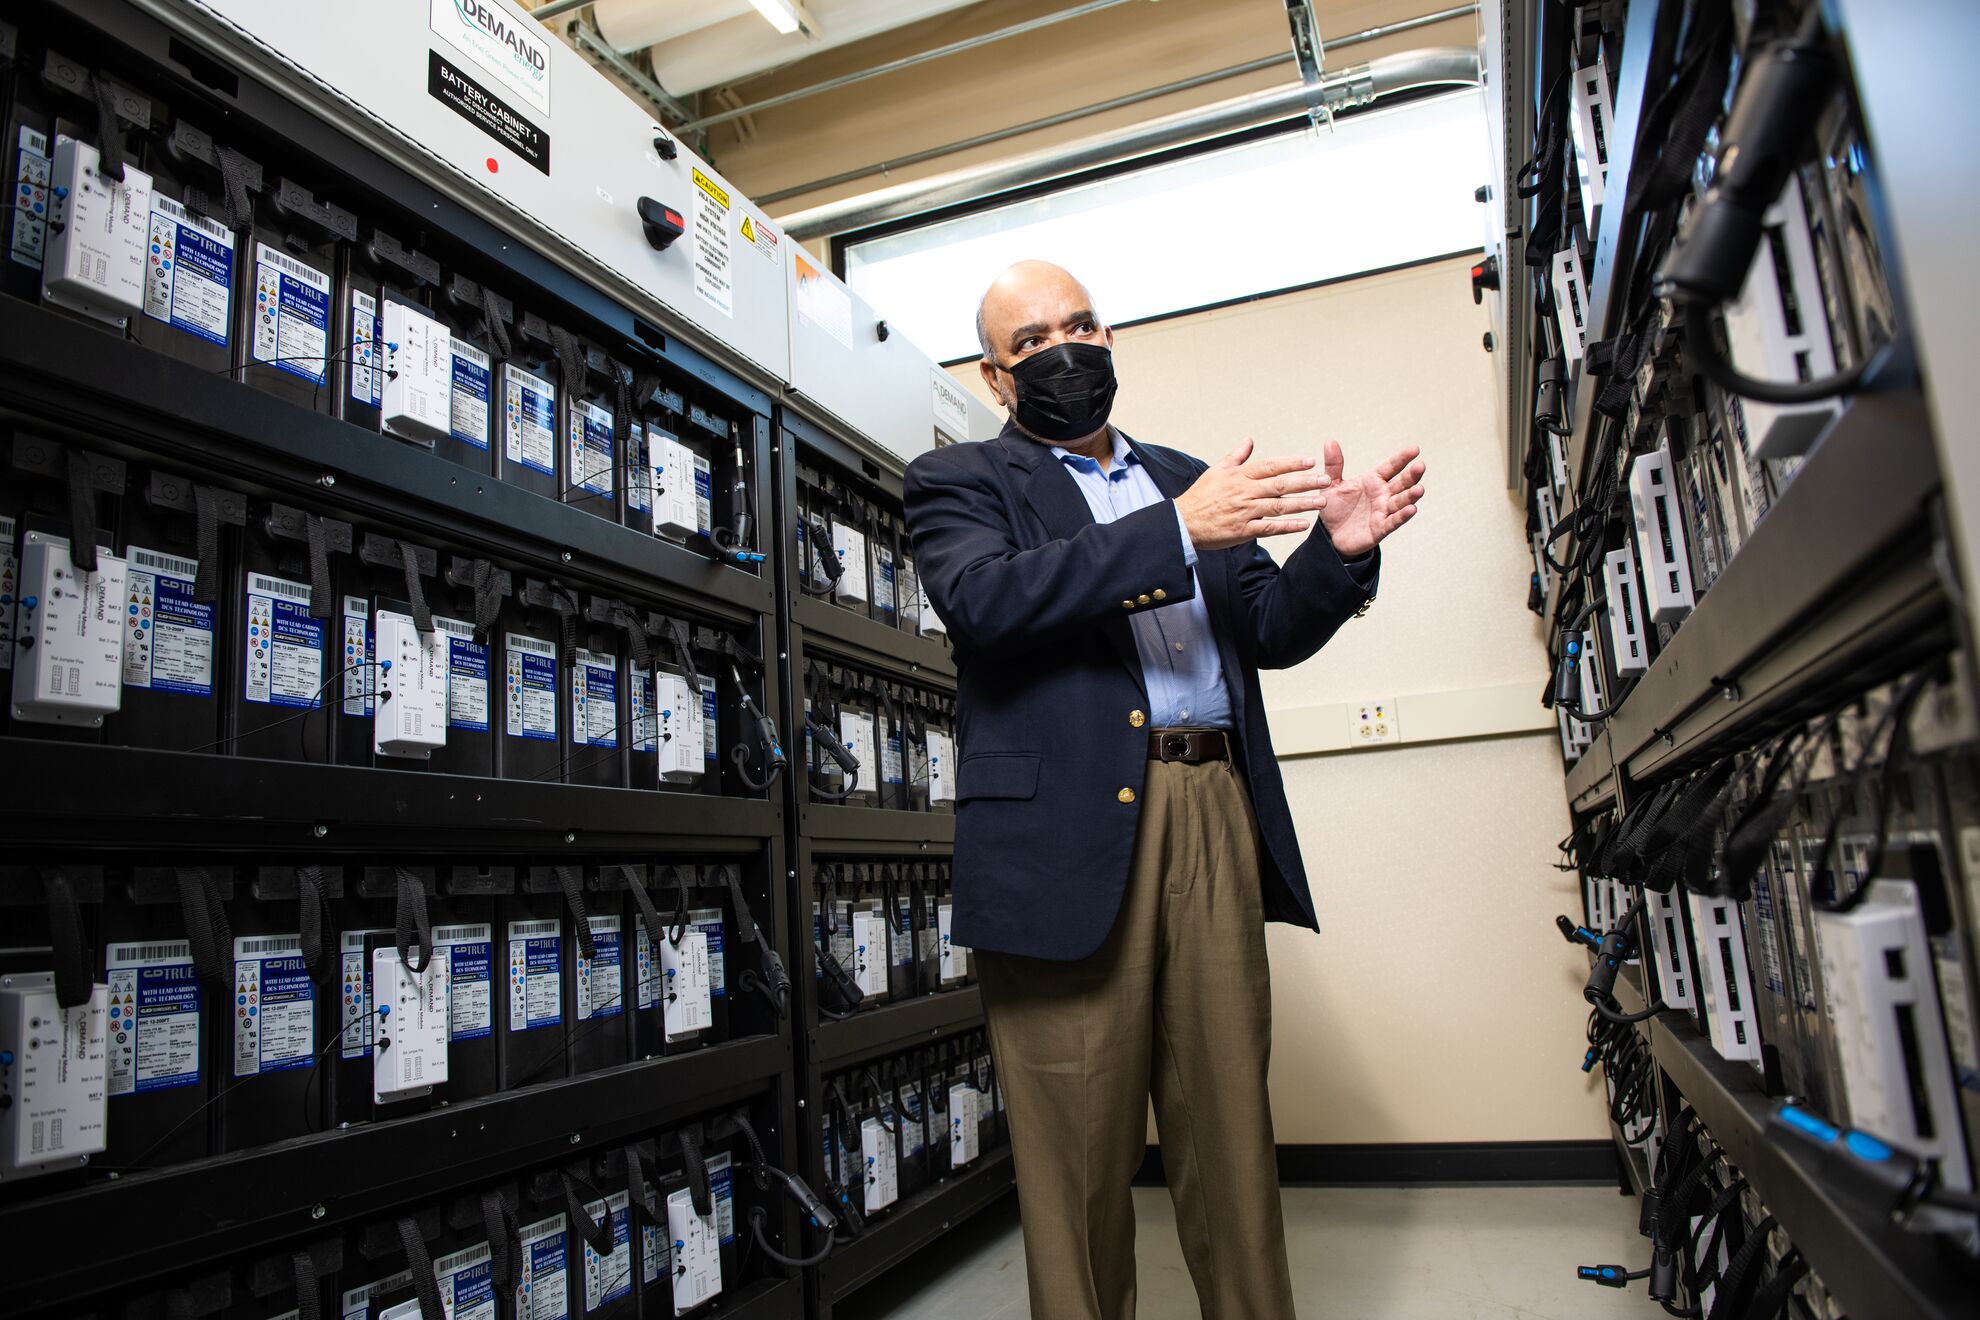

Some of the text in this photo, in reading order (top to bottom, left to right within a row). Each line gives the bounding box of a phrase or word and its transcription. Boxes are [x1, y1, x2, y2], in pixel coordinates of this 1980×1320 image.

[463, 0, 545, 71] DEMAND
[441, 66, 538, 143] BATTERY CABINET 1
[442, 88, 539, 159] AUTHORIZED SERVICE PERSONNEL ONLY
[472, 100, 503, 126] DISCONNECT
[504, 125, 520, 139] INSIDE
[700, 177, 727, 204] CAUTION
[200, 236, 226, 258] TRUE
[194, 256, 225, 275] TECHNOLOGY
[300, 285, 324, 303] TRUE
[940, 385, 966, 414] DEMAND
[180, 584, 194, 595] TR
[160, 597, 174, 605] WITH
[190, 602, 211, 612] CARBON
[174, 606, 208, 618] TECHNOLOGY
[294, 605, 310, 618] TRU
[164, 966, 195, 980] TRUE
[283, 959, 306, 971] TRU
[158, 993, 194, 1002] TECHNOLOGY
